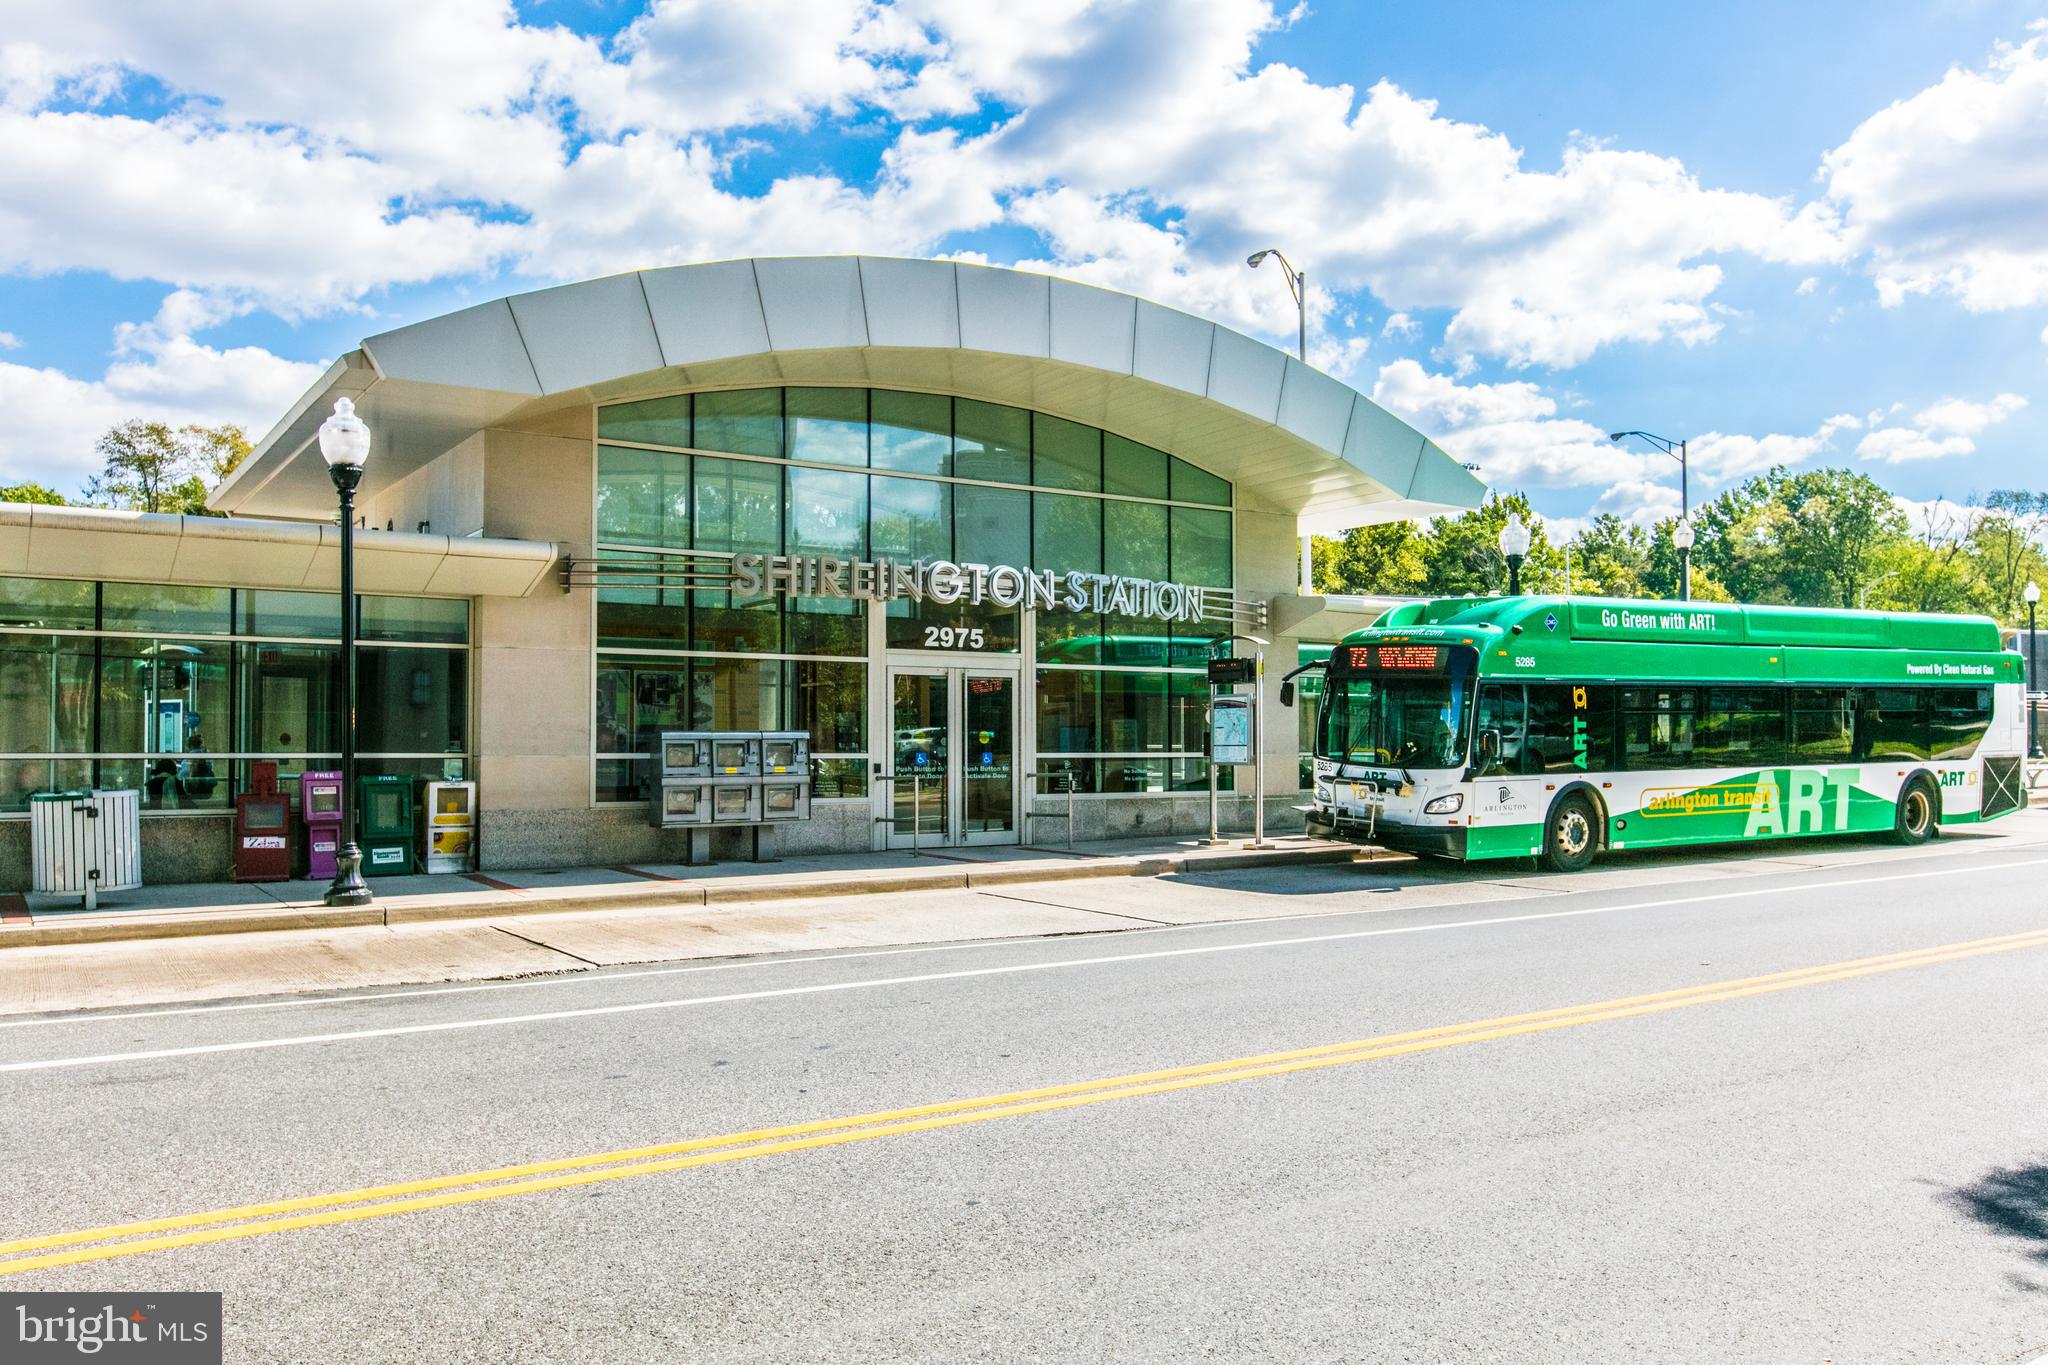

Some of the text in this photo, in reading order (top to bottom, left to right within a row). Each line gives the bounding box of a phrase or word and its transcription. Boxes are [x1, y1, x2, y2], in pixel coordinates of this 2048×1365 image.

[731, 553, 1203, 623] SHIRLINGTON STATION
[1601, 609, 1715, 630] Go Green with ART!
[924, 626, 984, 649] 2975
[1348, 647, 1368, 668] 72
[1515, 656, 1536, 667] 5285
[1906, 664, 1994, 677] Powered By Clean Natural Gas
[1573, 716, 1587, 769] ART
[1941, 771, 1965, 787] ART
[1484, 804, 1528, 812] ARLINGTON
[1649, 789, 1772, 813] arlington transit
[1743, 767, 1861, 838] ART
